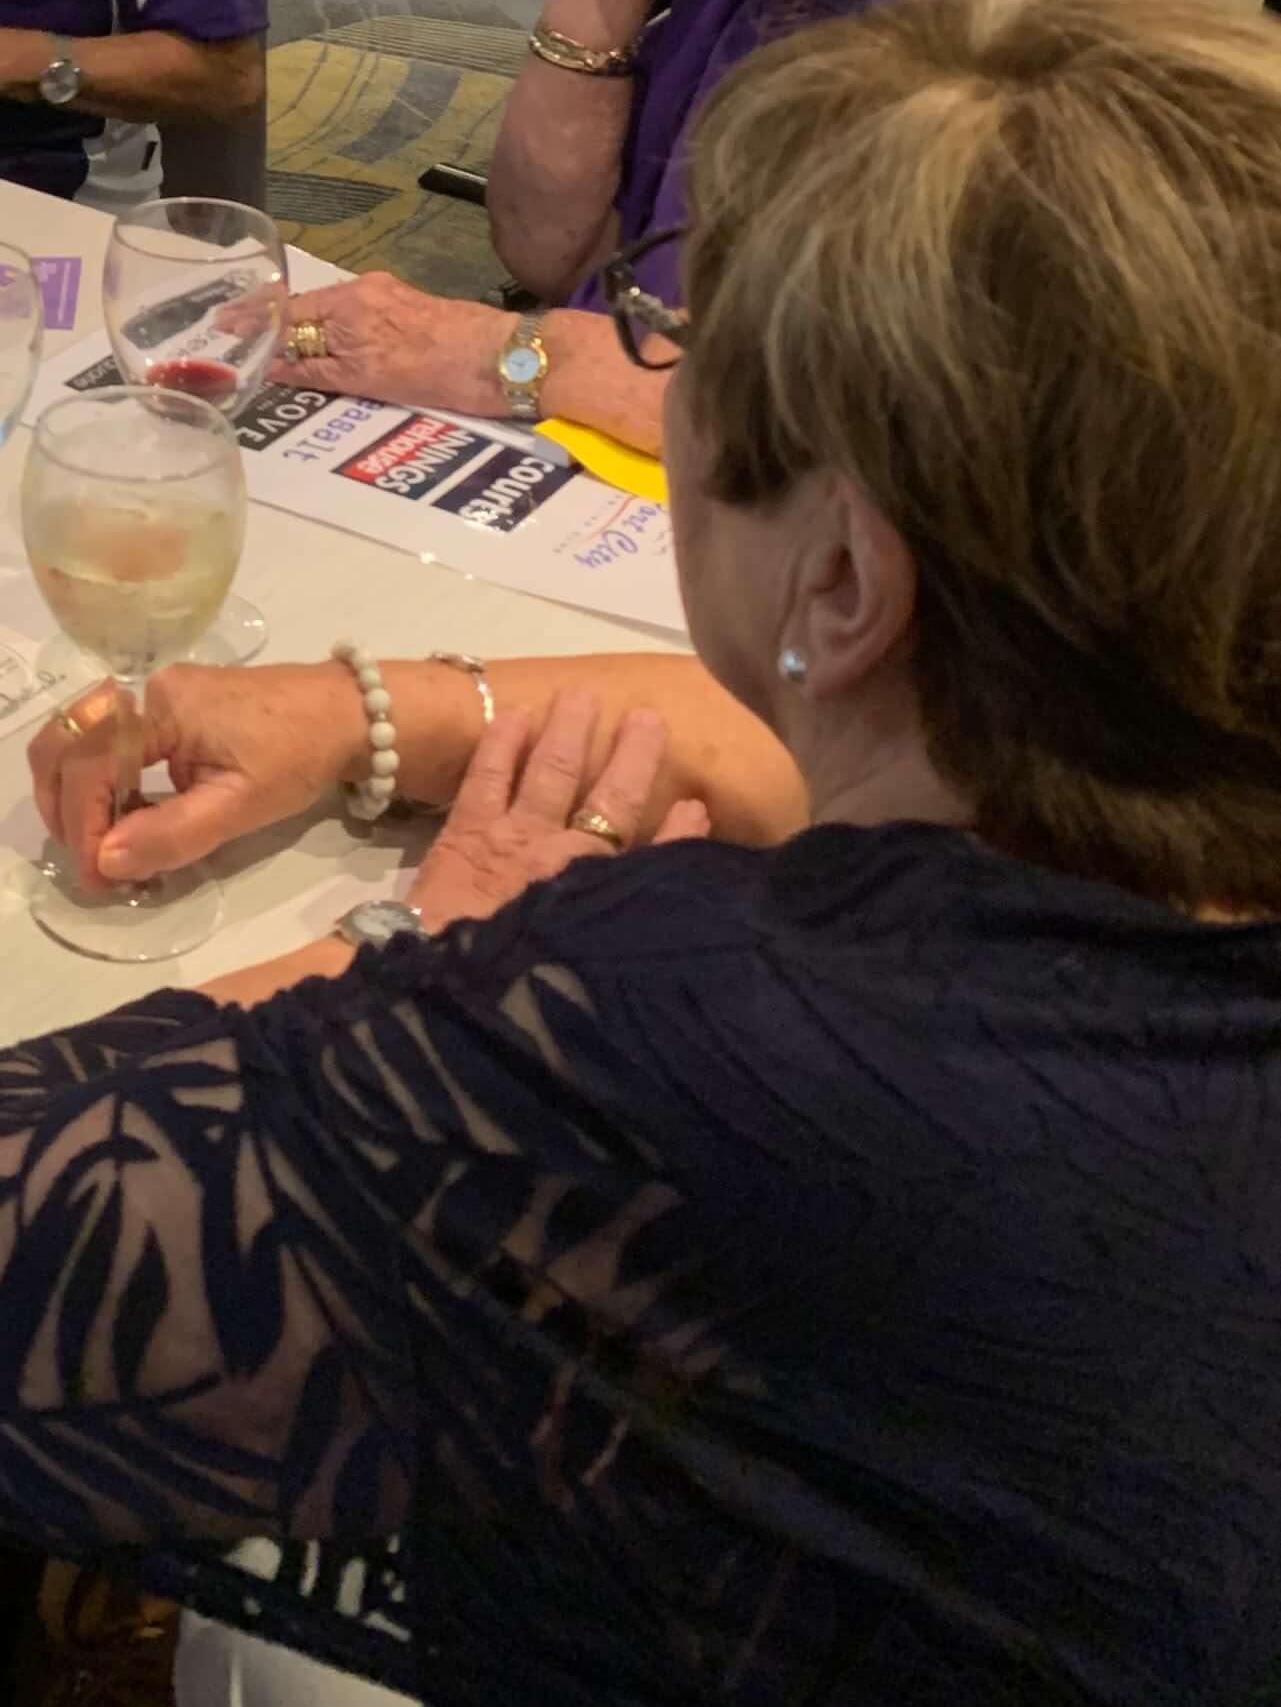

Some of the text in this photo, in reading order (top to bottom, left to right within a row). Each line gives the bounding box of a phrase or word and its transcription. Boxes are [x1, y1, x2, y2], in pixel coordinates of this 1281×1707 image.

[235, 391, 327, 442] GOVE
[356, 417, 444, 475] rehouse
[375, 428, 476, 494] NINGS
[459, 456, 556, 525] courts
[573, 530, 639, 569] City
